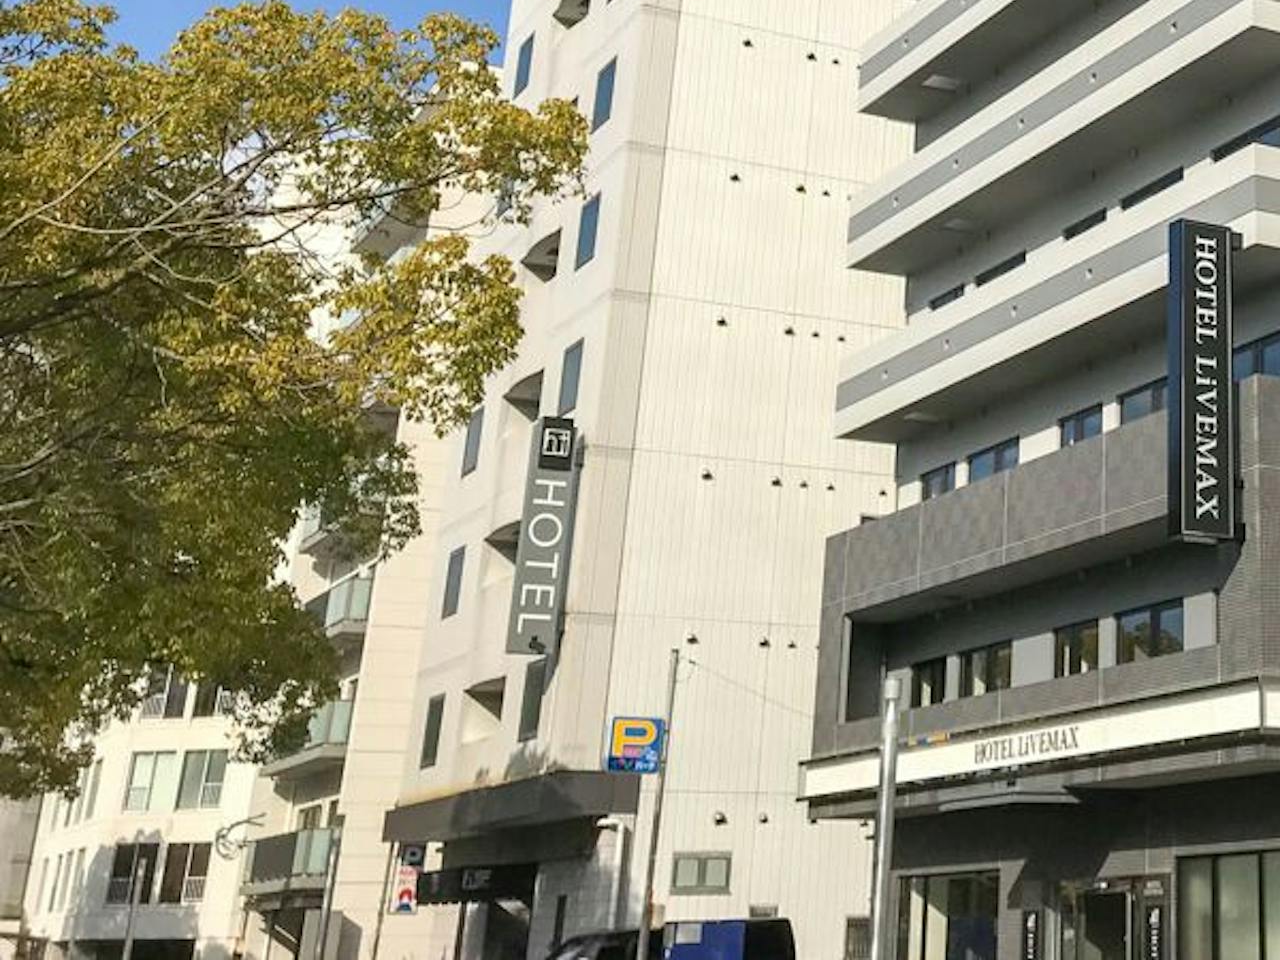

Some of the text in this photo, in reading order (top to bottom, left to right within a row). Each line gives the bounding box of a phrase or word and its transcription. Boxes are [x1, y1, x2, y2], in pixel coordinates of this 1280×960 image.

[1195, 235, 1218, 344] HOTEL
[516, 478, 568, 635] HOTEL
[613, 720, 656, 756] P
[974, 739, 1015, 765] HOTEL
